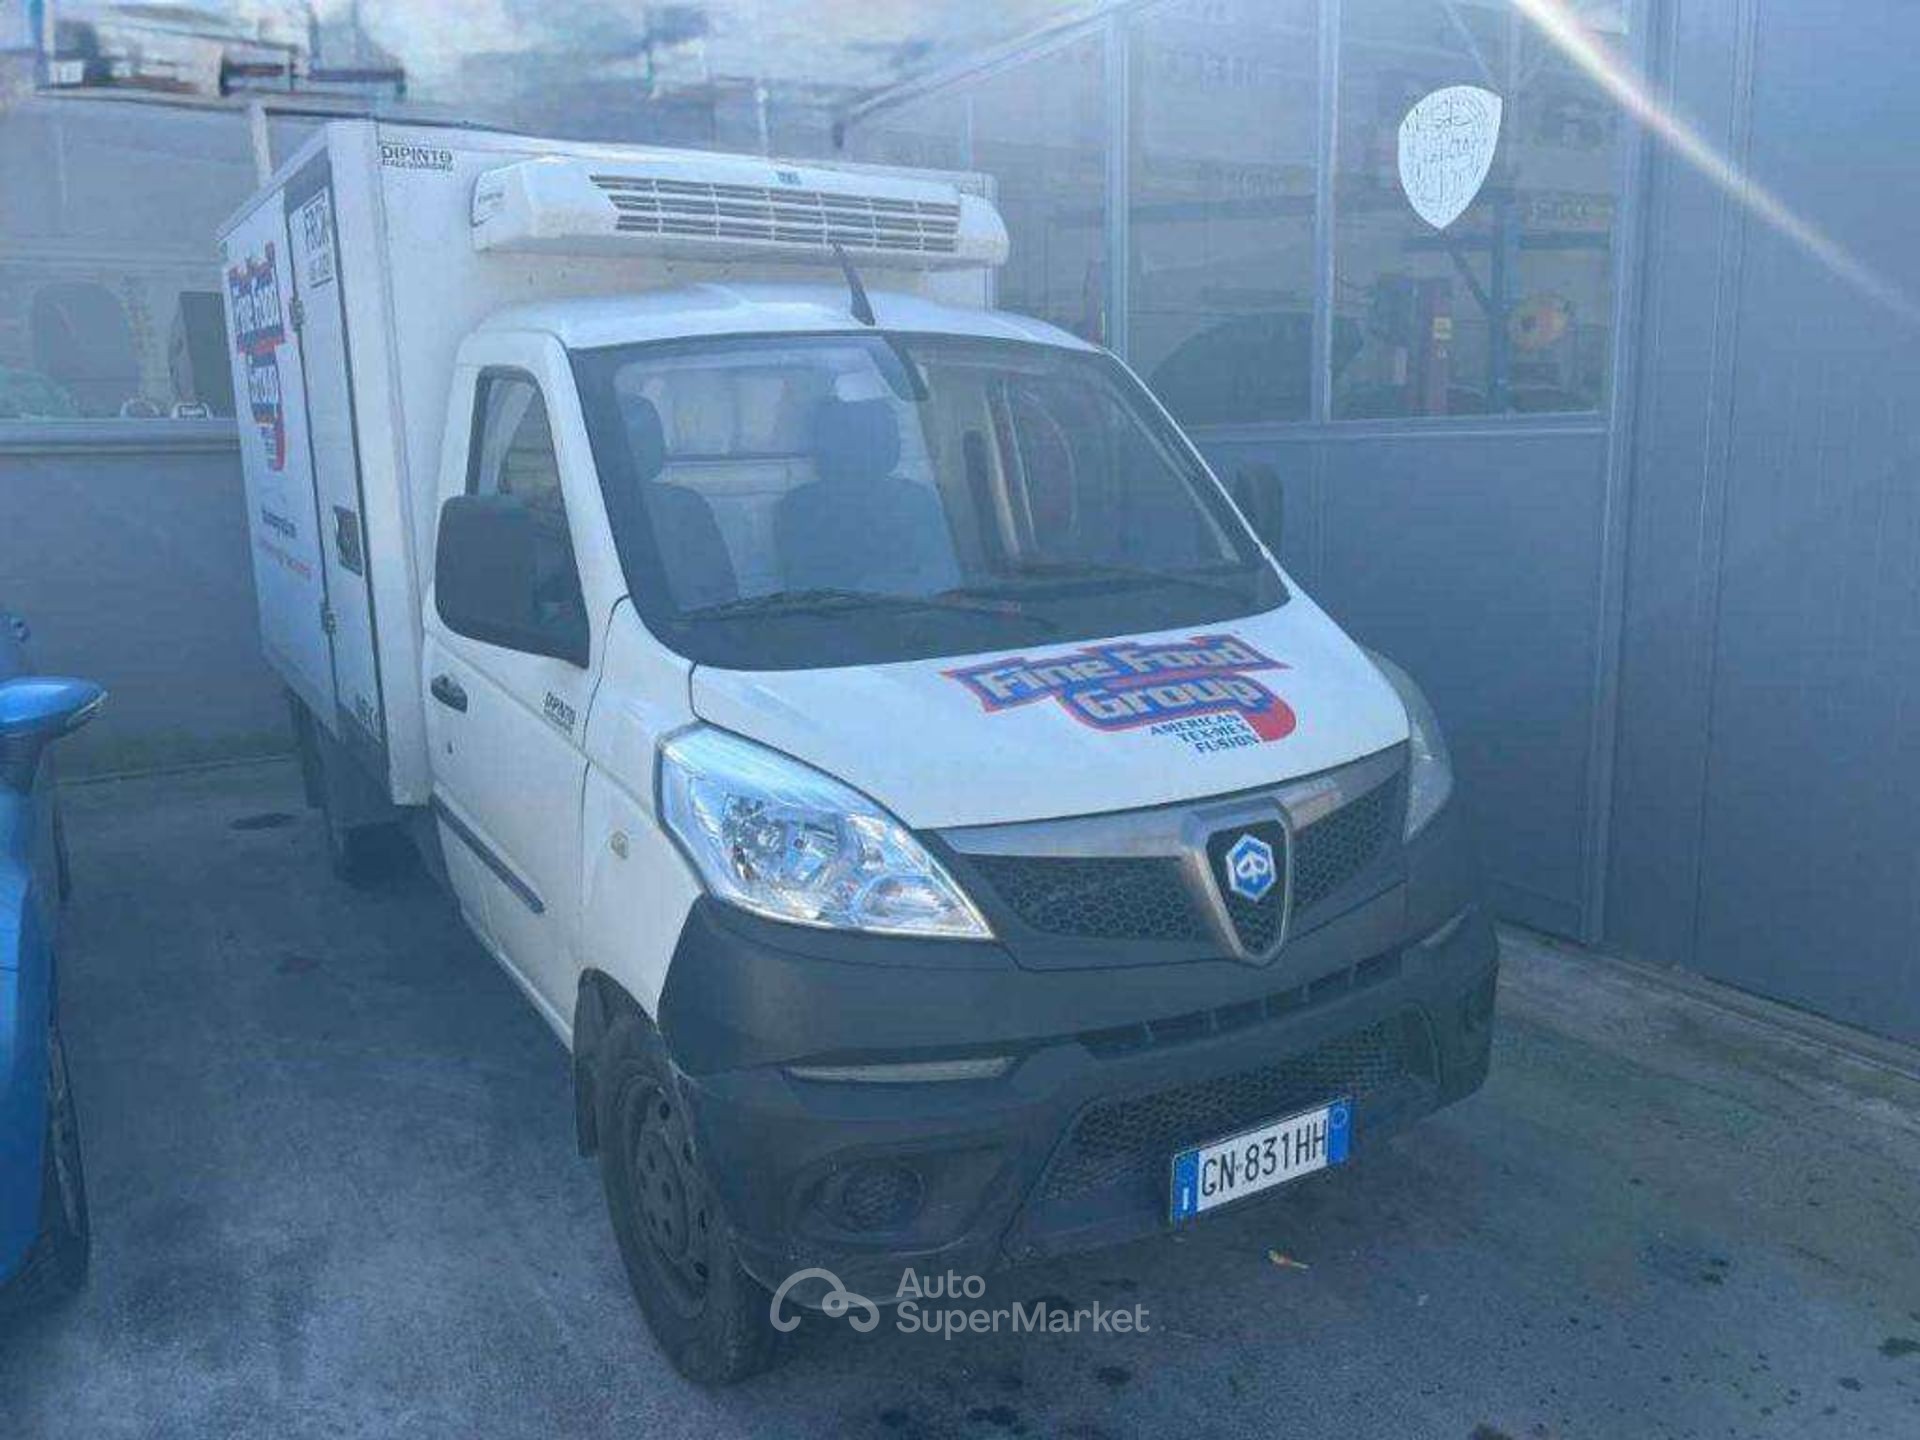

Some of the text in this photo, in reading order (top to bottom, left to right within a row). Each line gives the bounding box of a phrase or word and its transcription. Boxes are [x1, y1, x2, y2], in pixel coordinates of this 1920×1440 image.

[381, 145, 453, 162] DIPINTO
[975, 642, 1256, 699] Fine Food
[1077, 679, 1265, 718] Group
[1150, 713, 1242, 735] AMERICAN
[1194, 734, 1259, 753] FUSION
